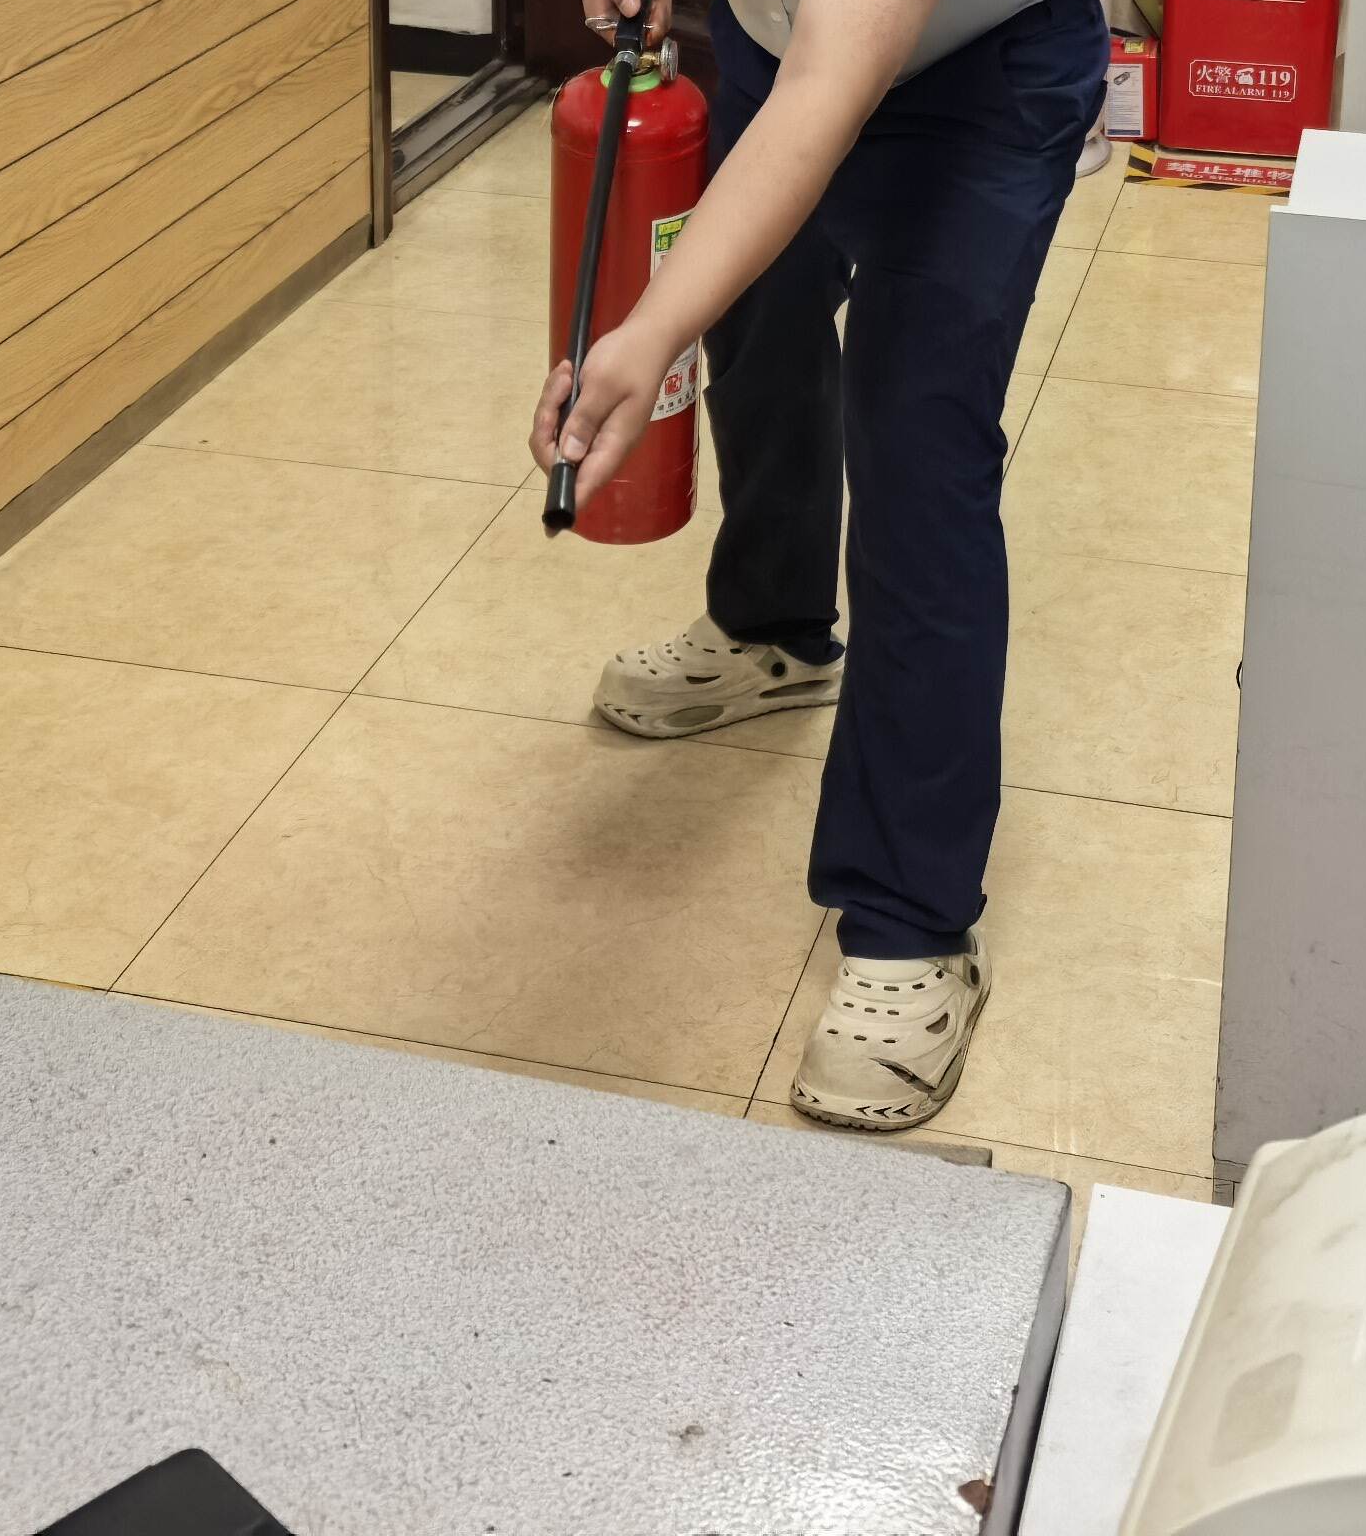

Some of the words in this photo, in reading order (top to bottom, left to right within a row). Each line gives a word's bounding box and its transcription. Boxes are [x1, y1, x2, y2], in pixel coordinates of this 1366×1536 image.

[1258, 69, 1291, 86] 119
[1195, 84, 1222, 95] FIRE
[1224, 86, 1265, 97] ALARM
[1272, 89, 1290, 98] 119
